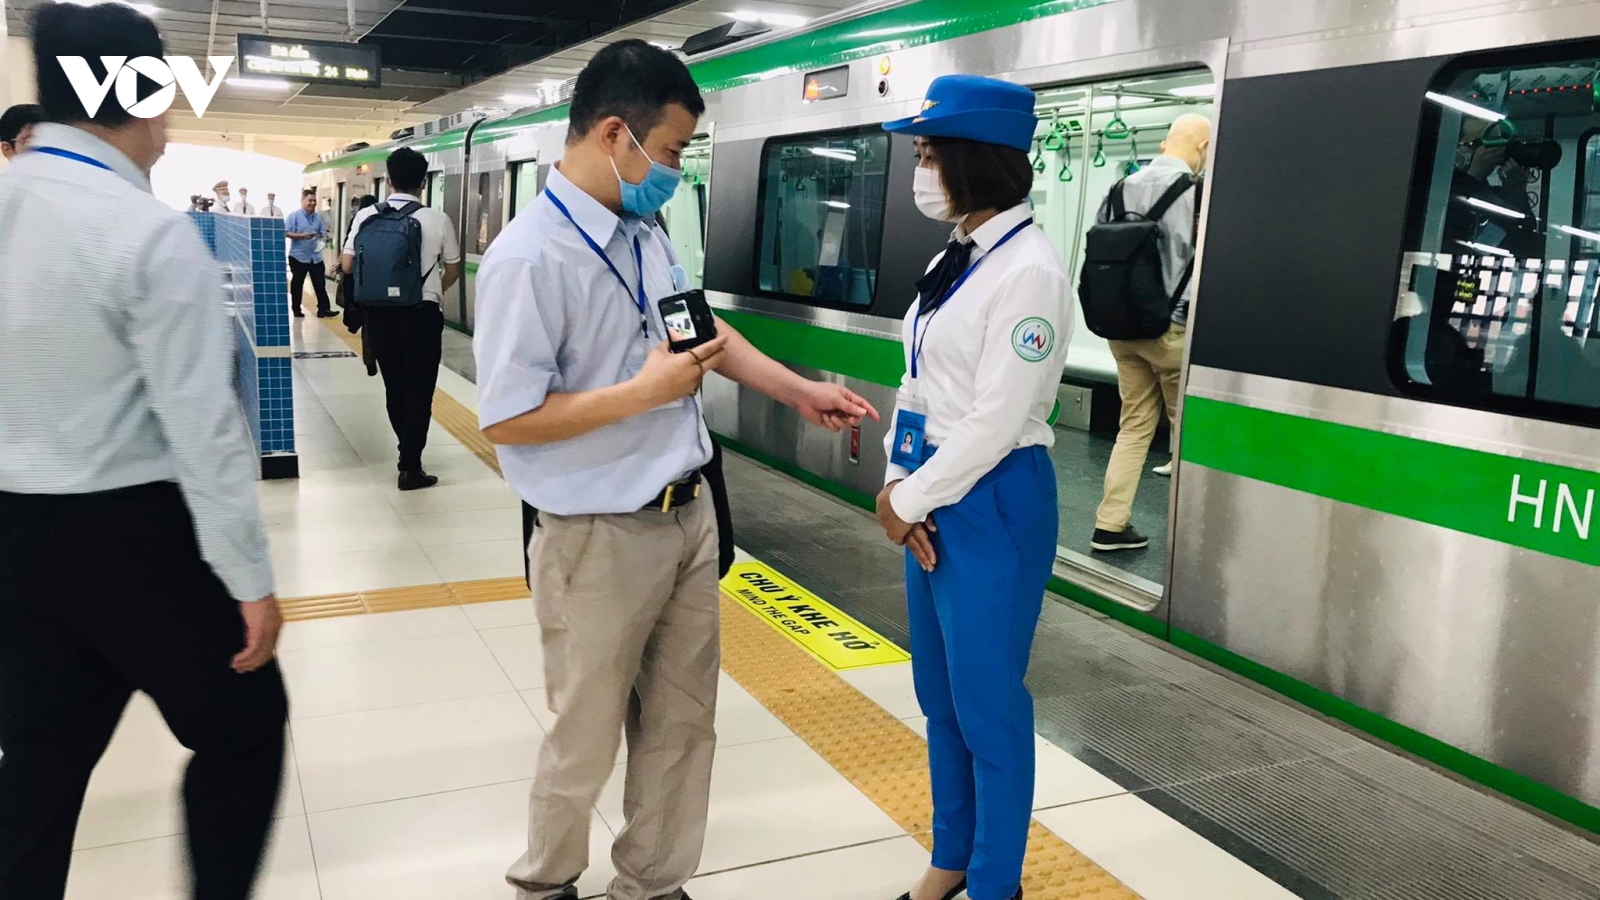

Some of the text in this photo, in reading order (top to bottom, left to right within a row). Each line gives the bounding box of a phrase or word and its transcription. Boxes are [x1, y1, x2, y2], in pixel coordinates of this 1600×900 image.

[324, 65, 338, 77] 24
[1507, 473, 1595, 540] HN
[736, 589, 811, 635] MIND THE GAP
[739, 572, 787, 593] CHÚ
[787, 604, 839, 629] KHE
